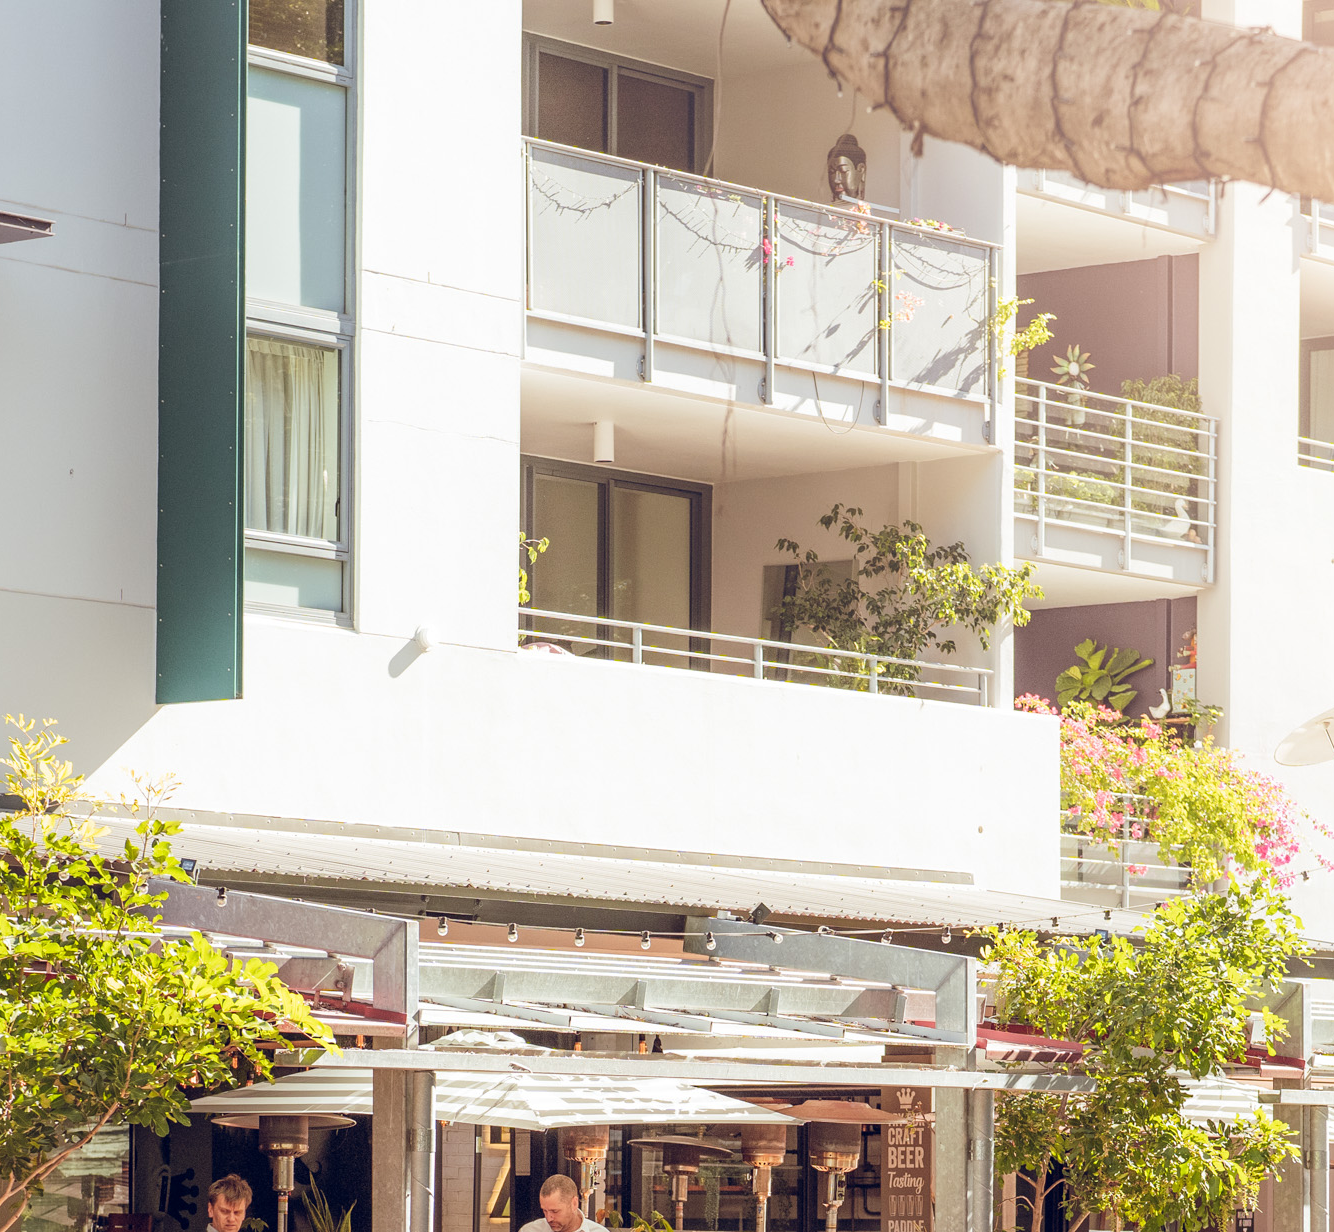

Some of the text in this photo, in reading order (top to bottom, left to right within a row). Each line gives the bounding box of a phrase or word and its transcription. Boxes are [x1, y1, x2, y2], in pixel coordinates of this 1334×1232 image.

[887, 1127, 925, 1145] CRAFT
[887, 1146, 925, 1169] BEER
[887, 1171, 925, 1195] Tasting
